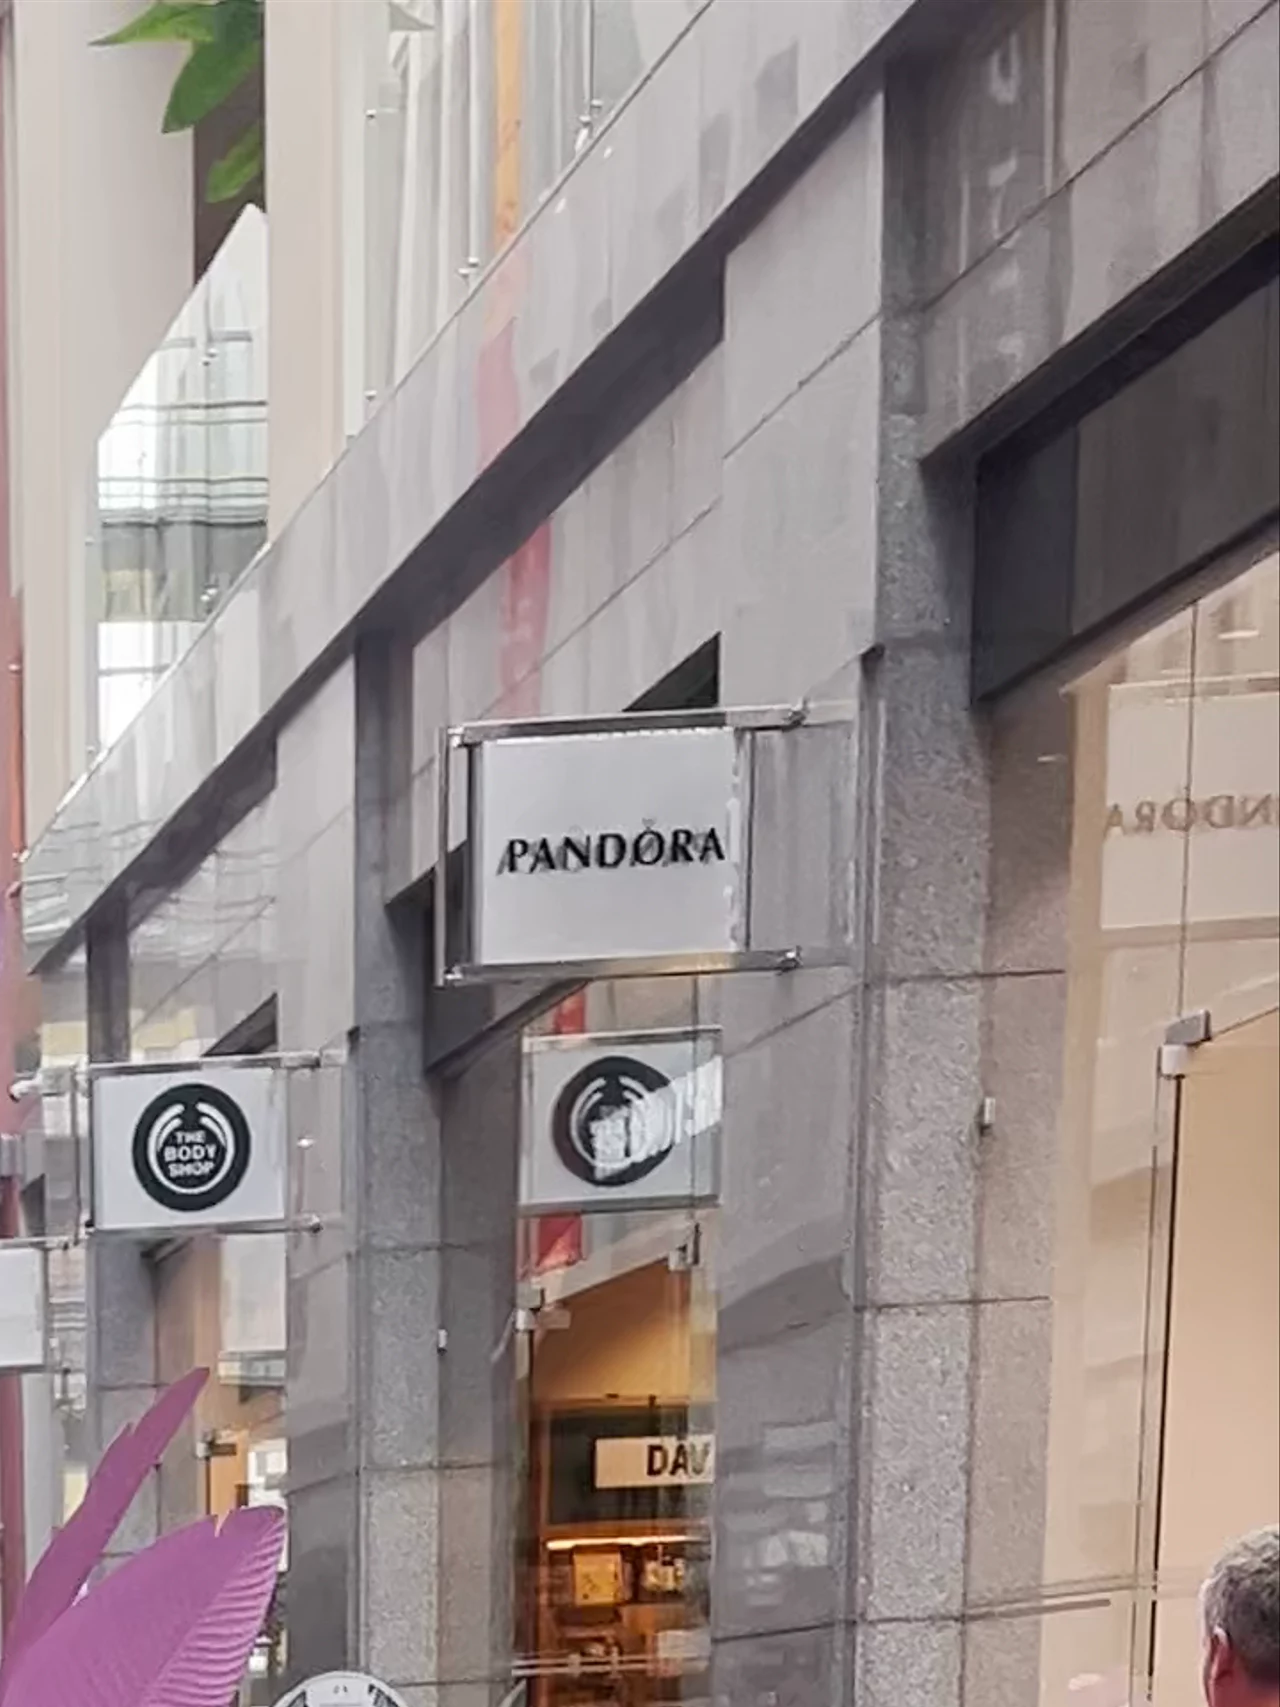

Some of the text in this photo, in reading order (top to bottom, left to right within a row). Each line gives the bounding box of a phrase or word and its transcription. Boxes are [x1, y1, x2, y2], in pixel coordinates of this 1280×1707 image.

[504, 818, 726, 874] PANDORA
[175, 1130, 206, 1144] THE
[164, 1144, 217, 1162] BODY
[168, 1161, 215, 1178] SHOP
